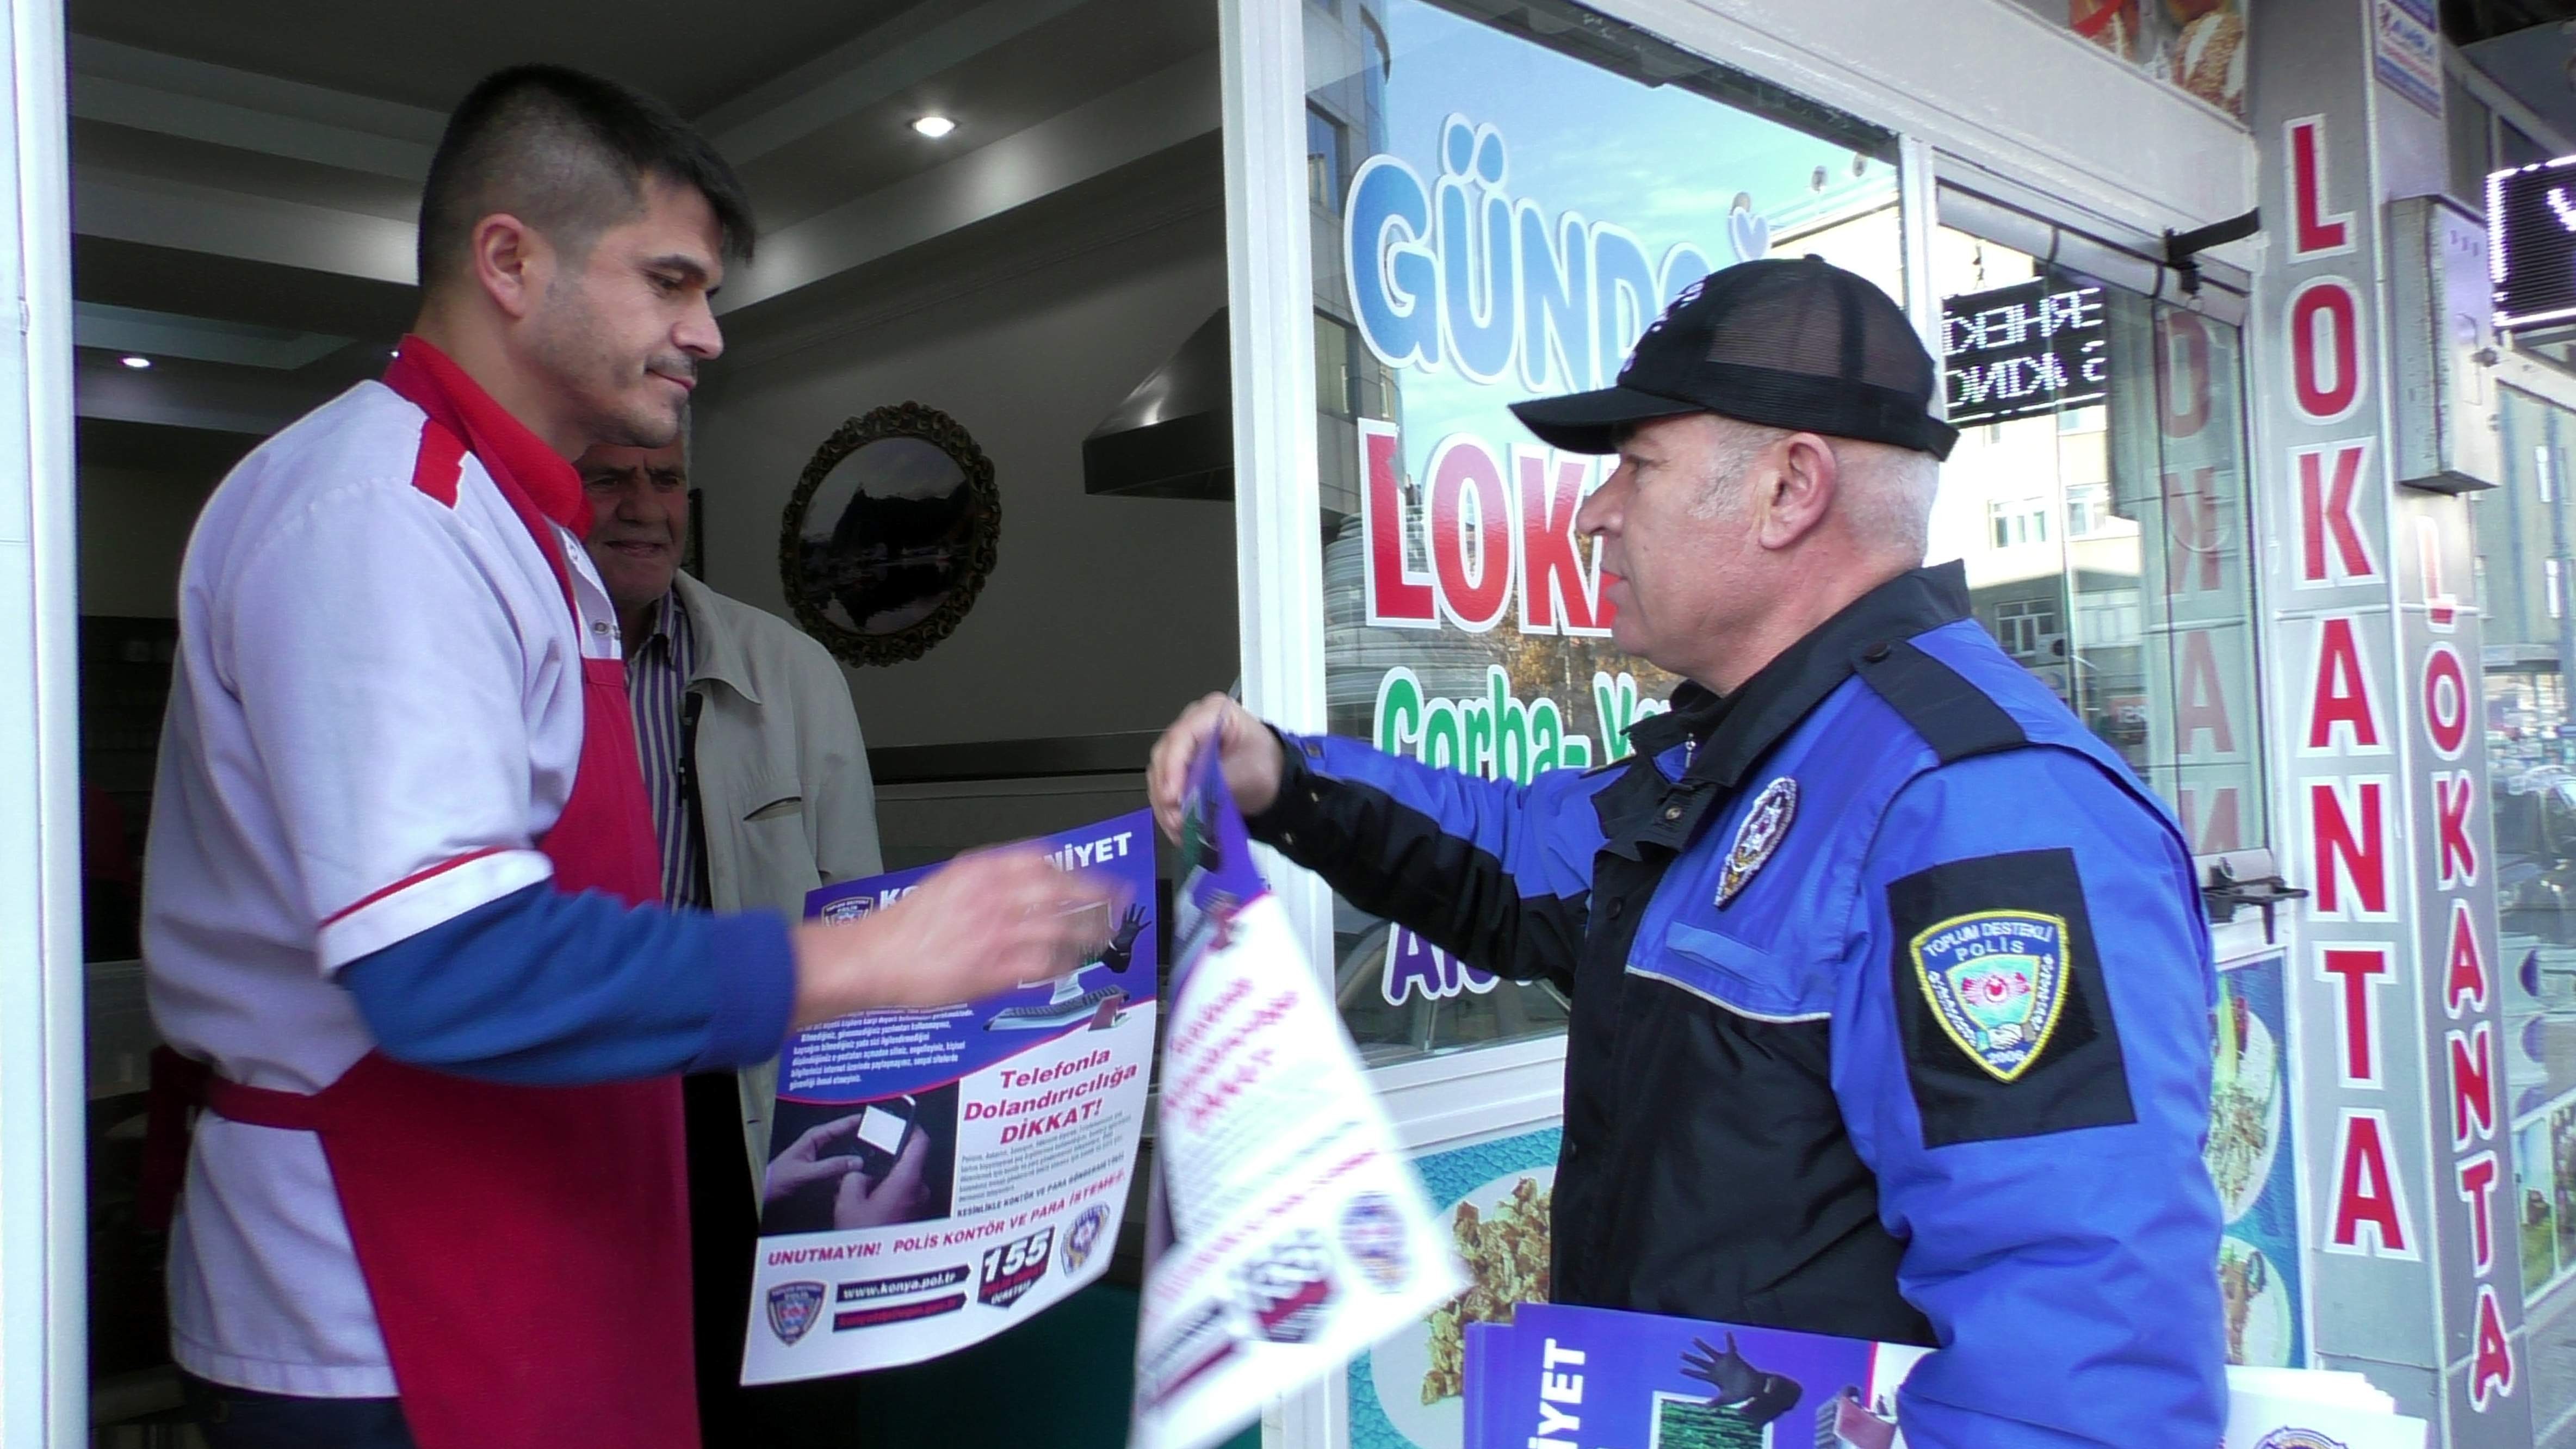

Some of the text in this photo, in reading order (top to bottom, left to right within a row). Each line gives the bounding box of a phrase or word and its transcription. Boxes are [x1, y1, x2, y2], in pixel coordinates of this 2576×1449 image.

[2282, 114, 2419, 1261] LOKANTA
[1924, 921, 2053, 957] TOPLUM DESTEKLİ
[1955, 936, 2024, 961] POLİS
[2416, 515, 2515, 1414] LOKANTA
[964, 1064, 1138, 1120] Dolandırıcılığa
[1000, 1049, 1111, 1089] Telefonla
[1000, 1098, 1104, 1144] DİKKAT!
[767, 1242, 882, 1266] UNUTMAYIN!
[893, 1233, 938, 1254] POLİS
[943, 1219, 1005, 1246] KONTÖR
[1010, 1211, 1028, 1228] VE
[1030, 1199, 1065, 1222] PARA
[984, 1229, 1051, 1283] 155
[844, 1272, 956, 1300] www.konya.pol.tr
